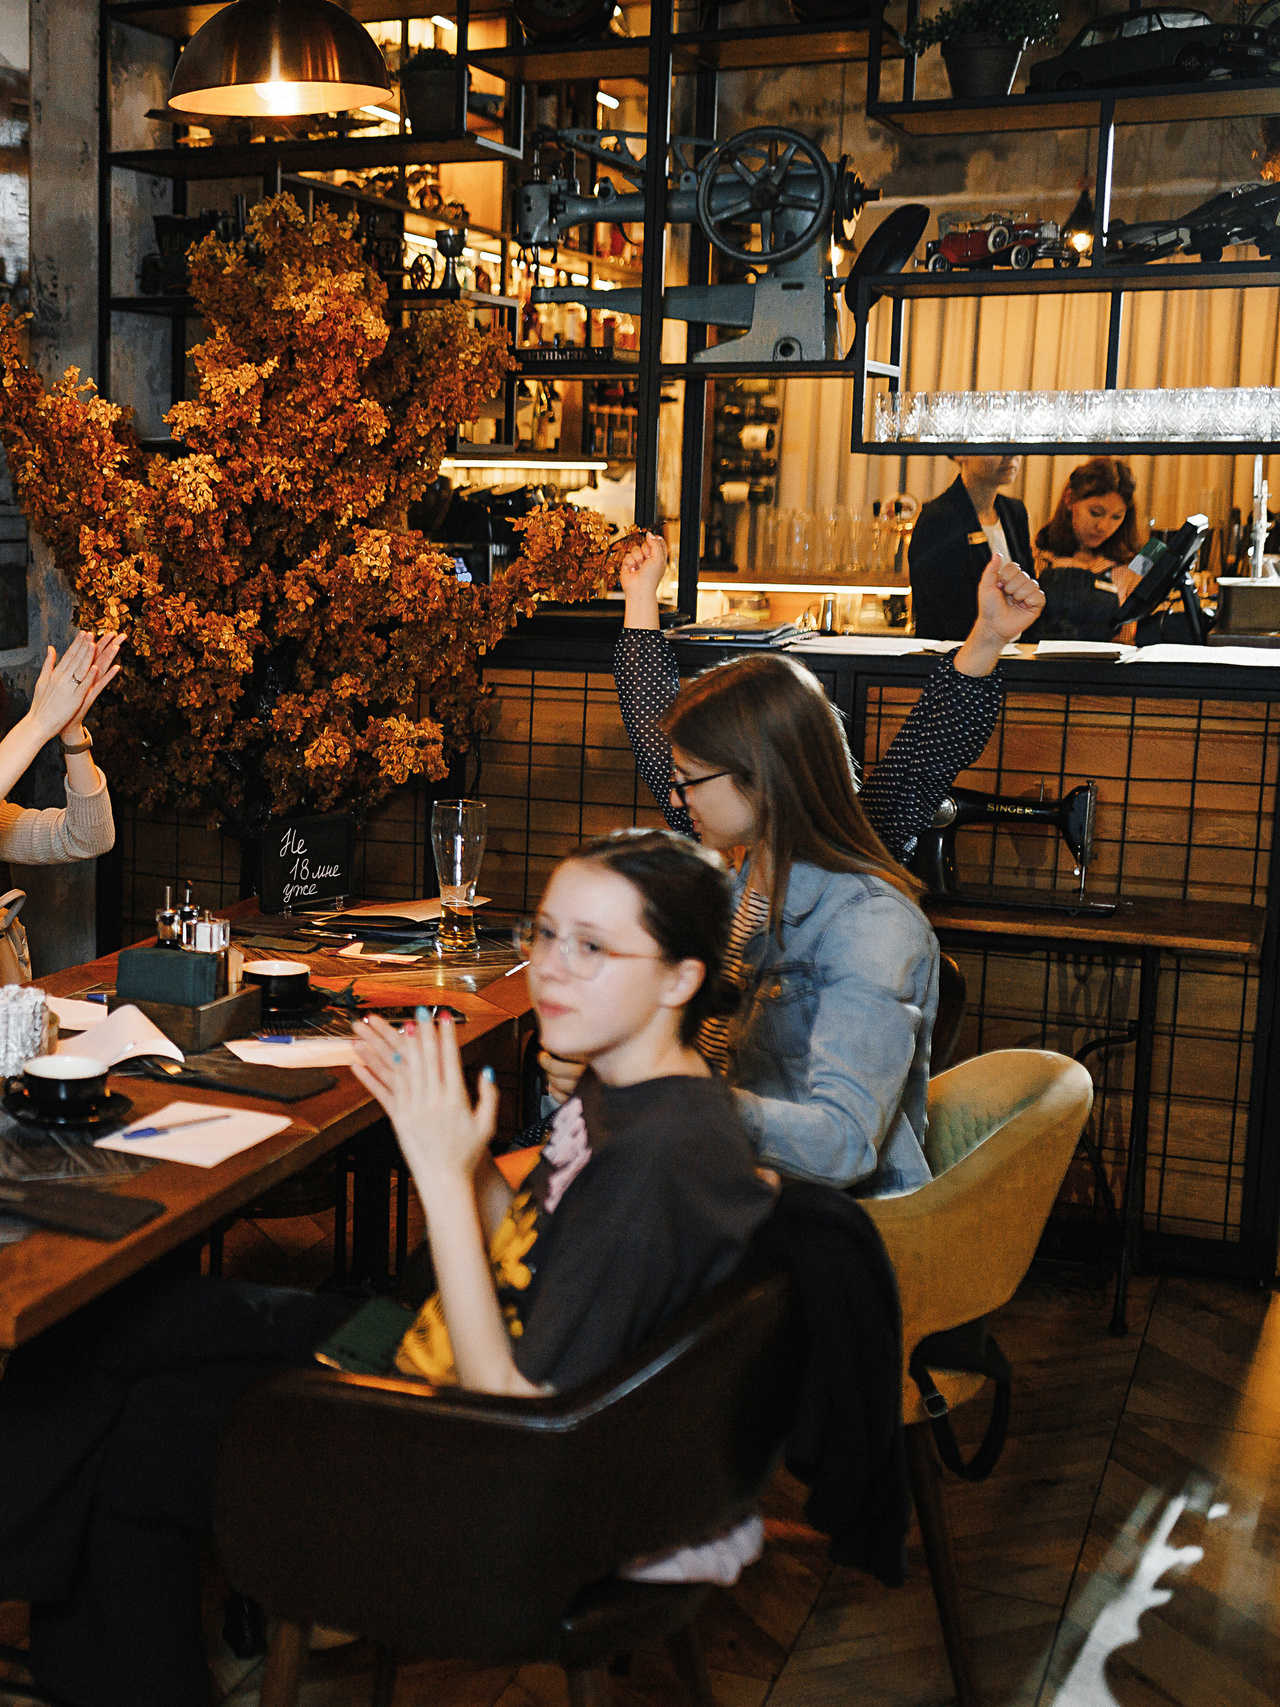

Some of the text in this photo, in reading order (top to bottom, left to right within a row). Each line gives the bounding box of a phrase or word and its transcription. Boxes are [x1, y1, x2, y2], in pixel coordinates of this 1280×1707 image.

[986, 803, 1034, 816] SINGER
[279, 827, 308, 858] Не
[289, 857, 342, 881] 18 мне
[282, 883, 318, 904] уже
